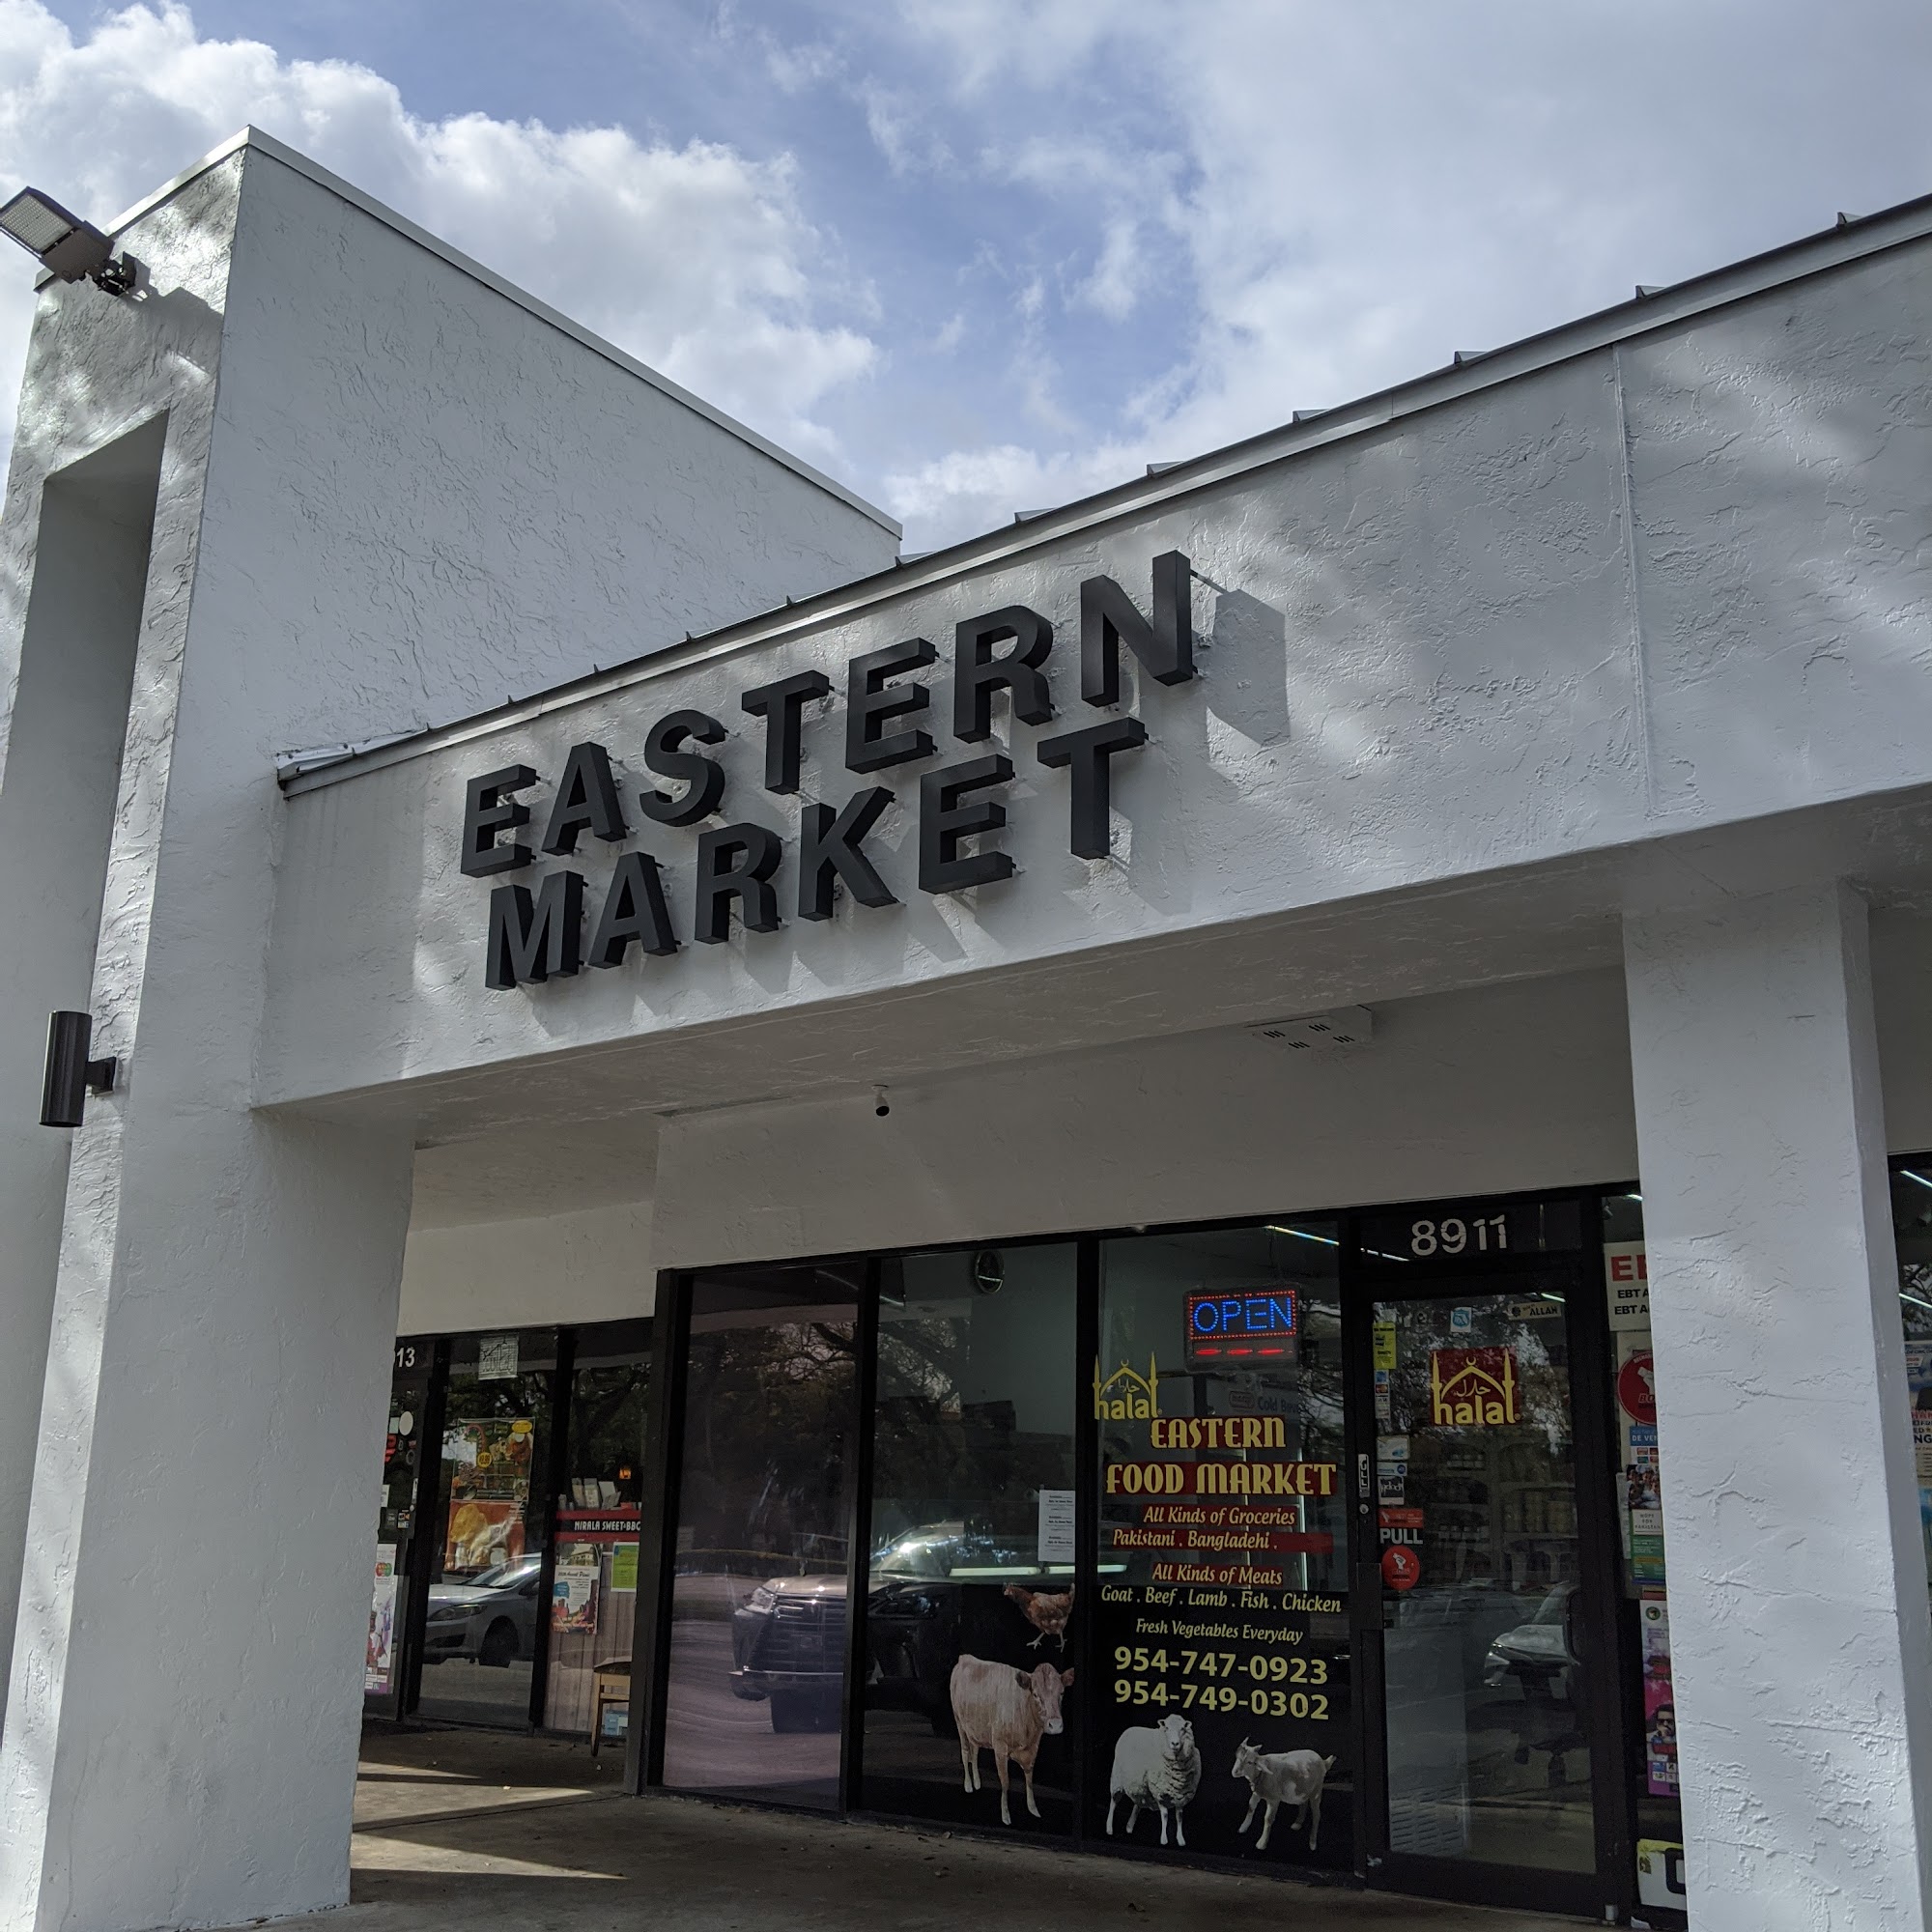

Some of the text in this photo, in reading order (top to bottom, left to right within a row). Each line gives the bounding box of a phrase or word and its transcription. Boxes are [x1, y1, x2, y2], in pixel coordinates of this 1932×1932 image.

[461, 550, 1194, 877] EASTERN
[485, 717, 1148, 990] MARKET
[1411, 1214, 1507, 1256] 8911
[1617, 1289, 1641, 1299] EBT
[1193, 1297, 1293, 1332] OPEN
[1614, 1305, 1638, 1315] EBT
[1151, 1417, 1286, 1448] EASTERN
[1106, 1463, 1338, 1495] FOOD MARKET
[1144, 1506, 1296, 1527] All Kinds of Groceries
[1113, 1529, 1270, 1551] Pakistani Bangladehi
[1379, 1528, 1423, 1545] PULL
[1151, 1563, 1283, 1586] All Kinds of Meats
[1101, 1584, 1342, 1613] Goat Beef Lamb Fish Chicken
[1136, 1618, 1304, 1646] Fresh Vegetables Everyday
[1114, 1646, 1328, 1685] 954-747-0923
[1114, 1679, 1329, 1720] 954-749-0302
